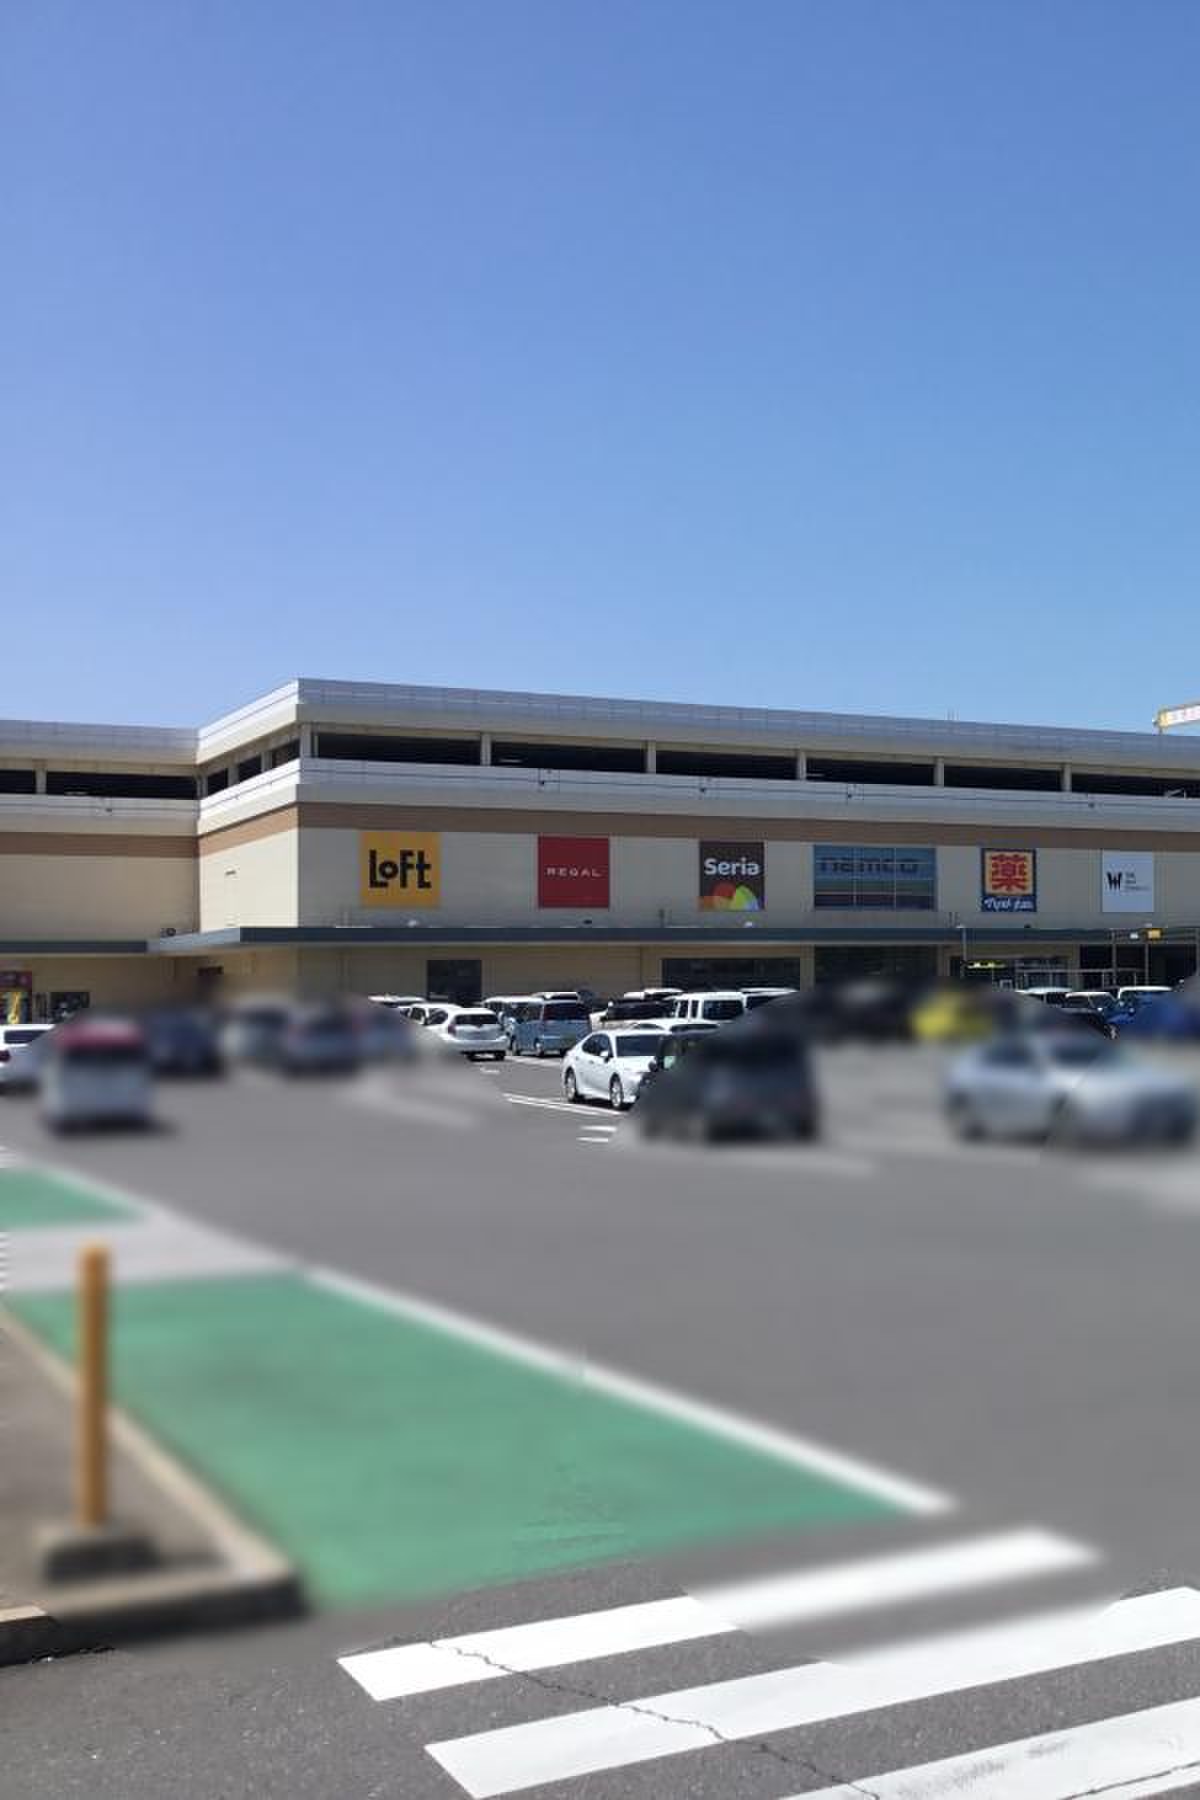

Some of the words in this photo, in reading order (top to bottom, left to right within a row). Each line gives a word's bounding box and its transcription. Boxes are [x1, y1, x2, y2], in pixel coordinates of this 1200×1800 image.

[547, 867, 601, 877] REGAL
[704, 857, 760, 876] Seria
[990, 853, 1027, 891] 薬
